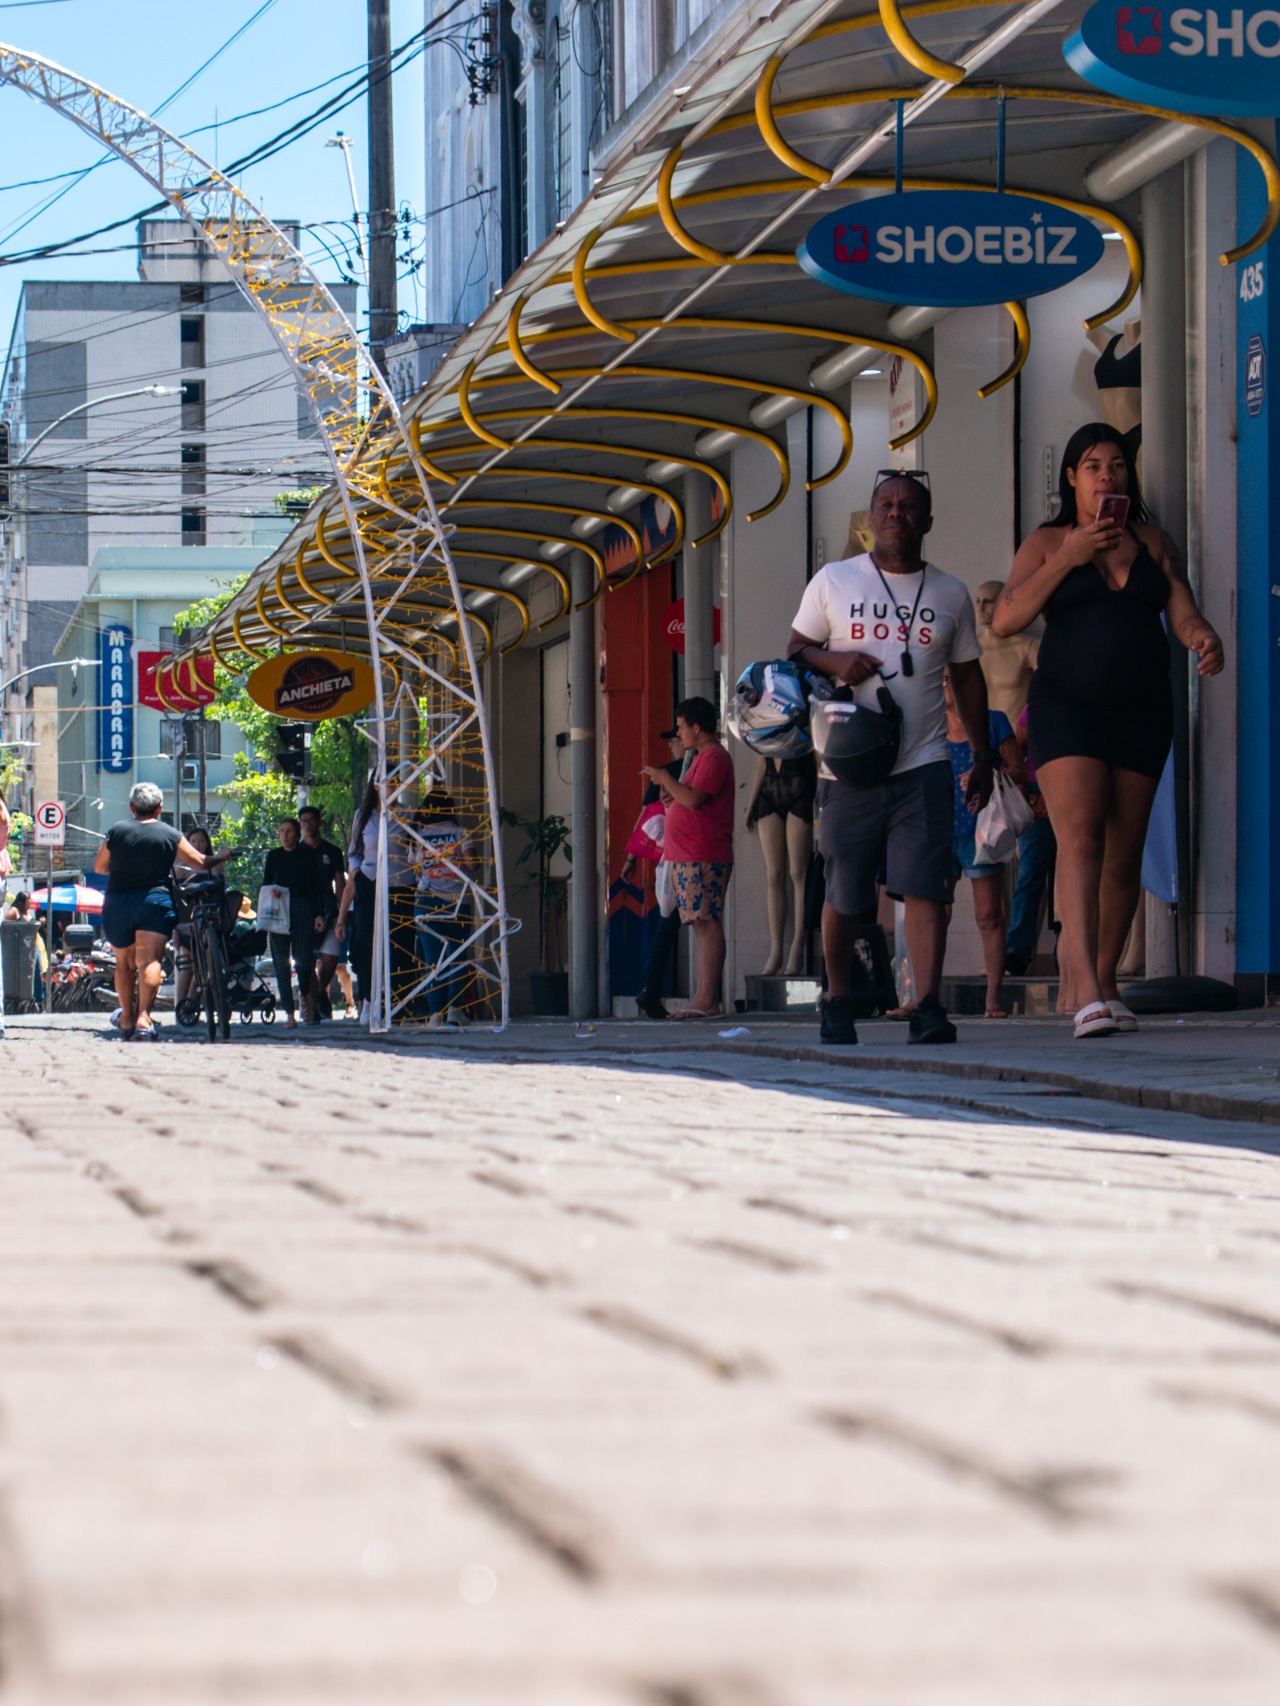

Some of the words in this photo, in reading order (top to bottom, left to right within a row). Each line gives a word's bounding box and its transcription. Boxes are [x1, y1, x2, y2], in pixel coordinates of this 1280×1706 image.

[875, 213, 1078, 265] SHOEBIZ
[1239, 261, 1264, 302] 435
[850, 602, 935, 623] HUGO
[851, 623, 932, 645] BOSS
[109, 631, 125, 767] MARABRAZ
[280, 675, 353, 704] ANCHIETA
[45, 808, 56, 824] E
[40, 832, 60, 840] MOTOS
